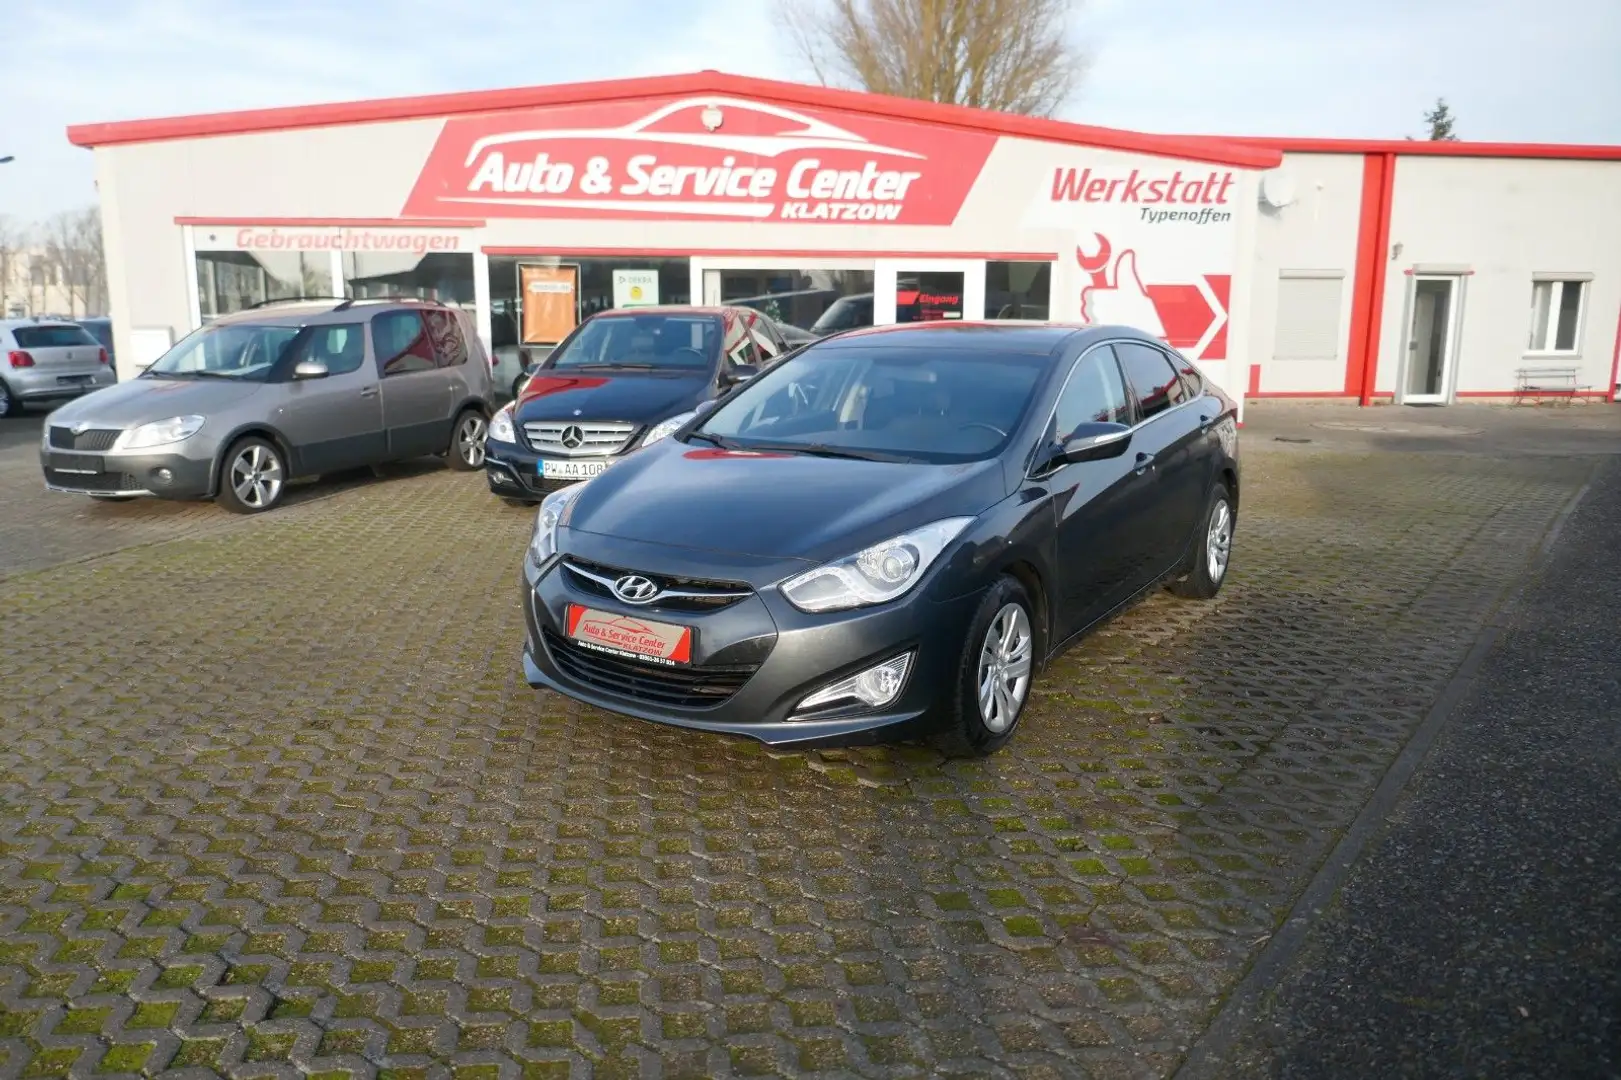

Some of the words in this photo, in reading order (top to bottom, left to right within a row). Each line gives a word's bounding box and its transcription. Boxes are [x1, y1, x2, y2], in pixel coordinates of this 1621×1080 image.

[467, 152, 575, 194] Auto
[579, 156, 613, 194] &
[620, 155, 778, 197] Service
[786, 159, 921, 200] Center
[1050, 168, 1235, 205] Werkstatt
[781, 203, 902, 221] KLATZOW
[1140, 207, 1232, 225] Typenoffen
[236, 228, 460, 255] Gebrauchtwagen
[919, 293, 958, 305] Eingang
[544, 462, 558, 474] PW
[565, 463, 579, 476] AA
[581, 463, 603, 476] 108
[583, 623, 600, 636] Auto
[601, 628, 607, 637] &
[608, 630, 637, 644] Service
[639, 635, 666, 649] Center
[623, 643, 663, 656] KLATZOW
